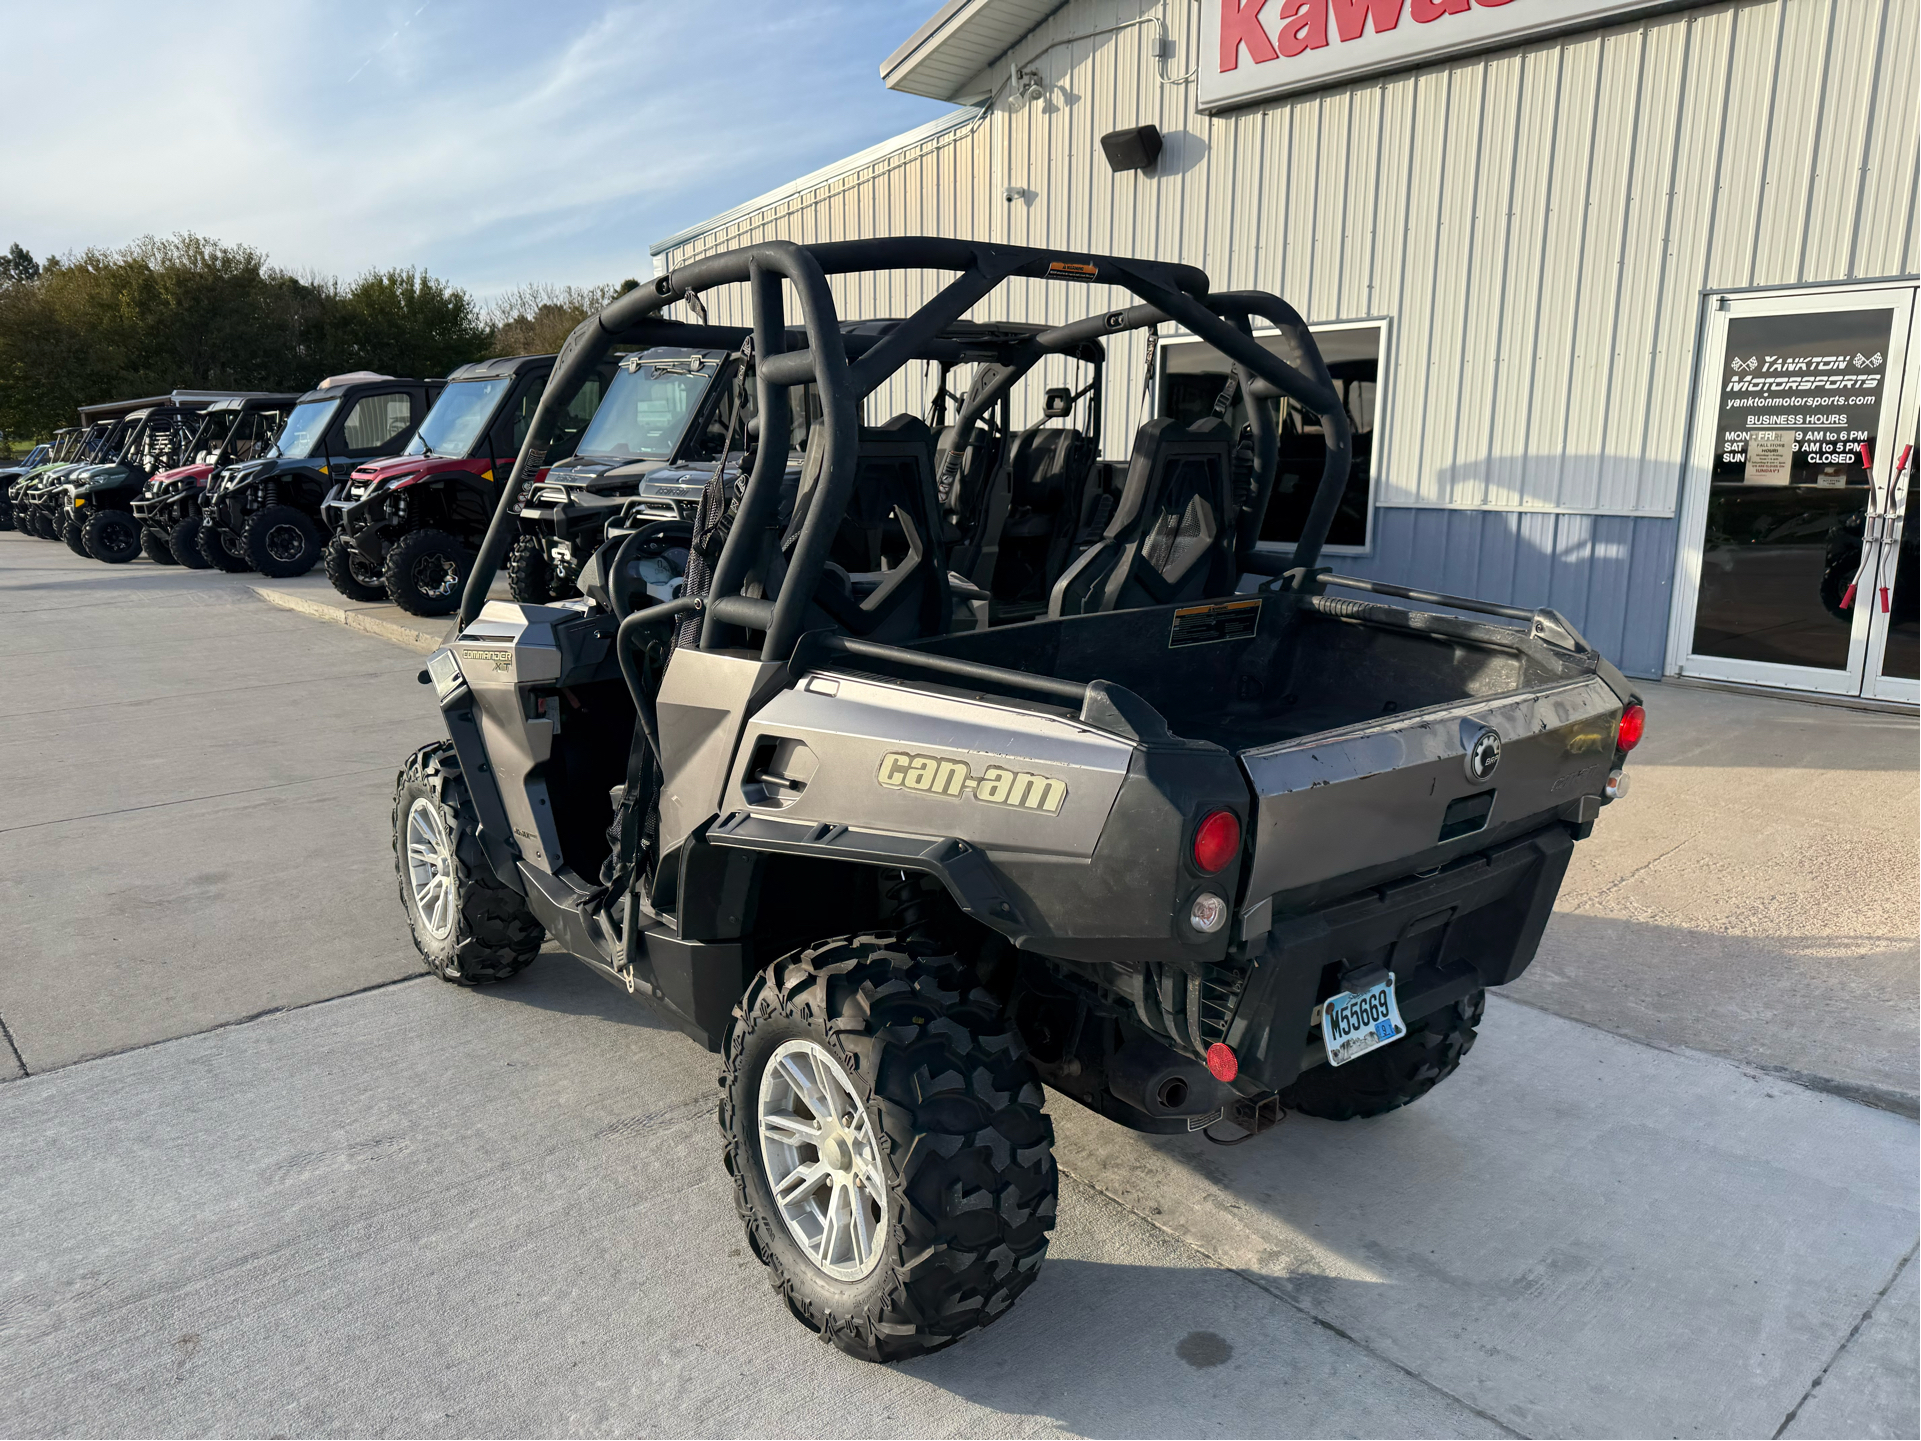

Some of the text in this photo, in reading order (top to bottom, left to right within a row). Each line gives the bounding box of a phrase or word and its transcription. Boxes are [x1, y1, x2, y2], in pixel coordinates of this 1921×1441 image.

[1219, 0, 1517, 73] Kaw
[1762, 356, 1850, 372] YANKTON
[1726, 375, 1881, 392] MOTORSPORTS
[1726, 396, 1876, 409] yanktonmotorsports.com
[1747, 414, 1848, 425] BUSINESS HOURS
[1725, 431, 1750, 441] MON
[1758, 431, 1776, 441] FRI
[1795, 431, 1803, 441] 9
[1805, 431, 1824, 441] AM
[1826, 431, 1837, 441] to
[1839, 431, 1848, 440] 6
[1850, 431, 1868, 441] PM
[1724, 442, 1862, 452] SAT 9 AM to 5 PM
[1723, 453, 1855, 464] SUN CLOSED
[463, 649, 513, 661] COMMANDER
[492, 662, 511, 672] XT
[877, 752, 1067, 815] can-am
[1330, 989, 1390, 1041] M55669
